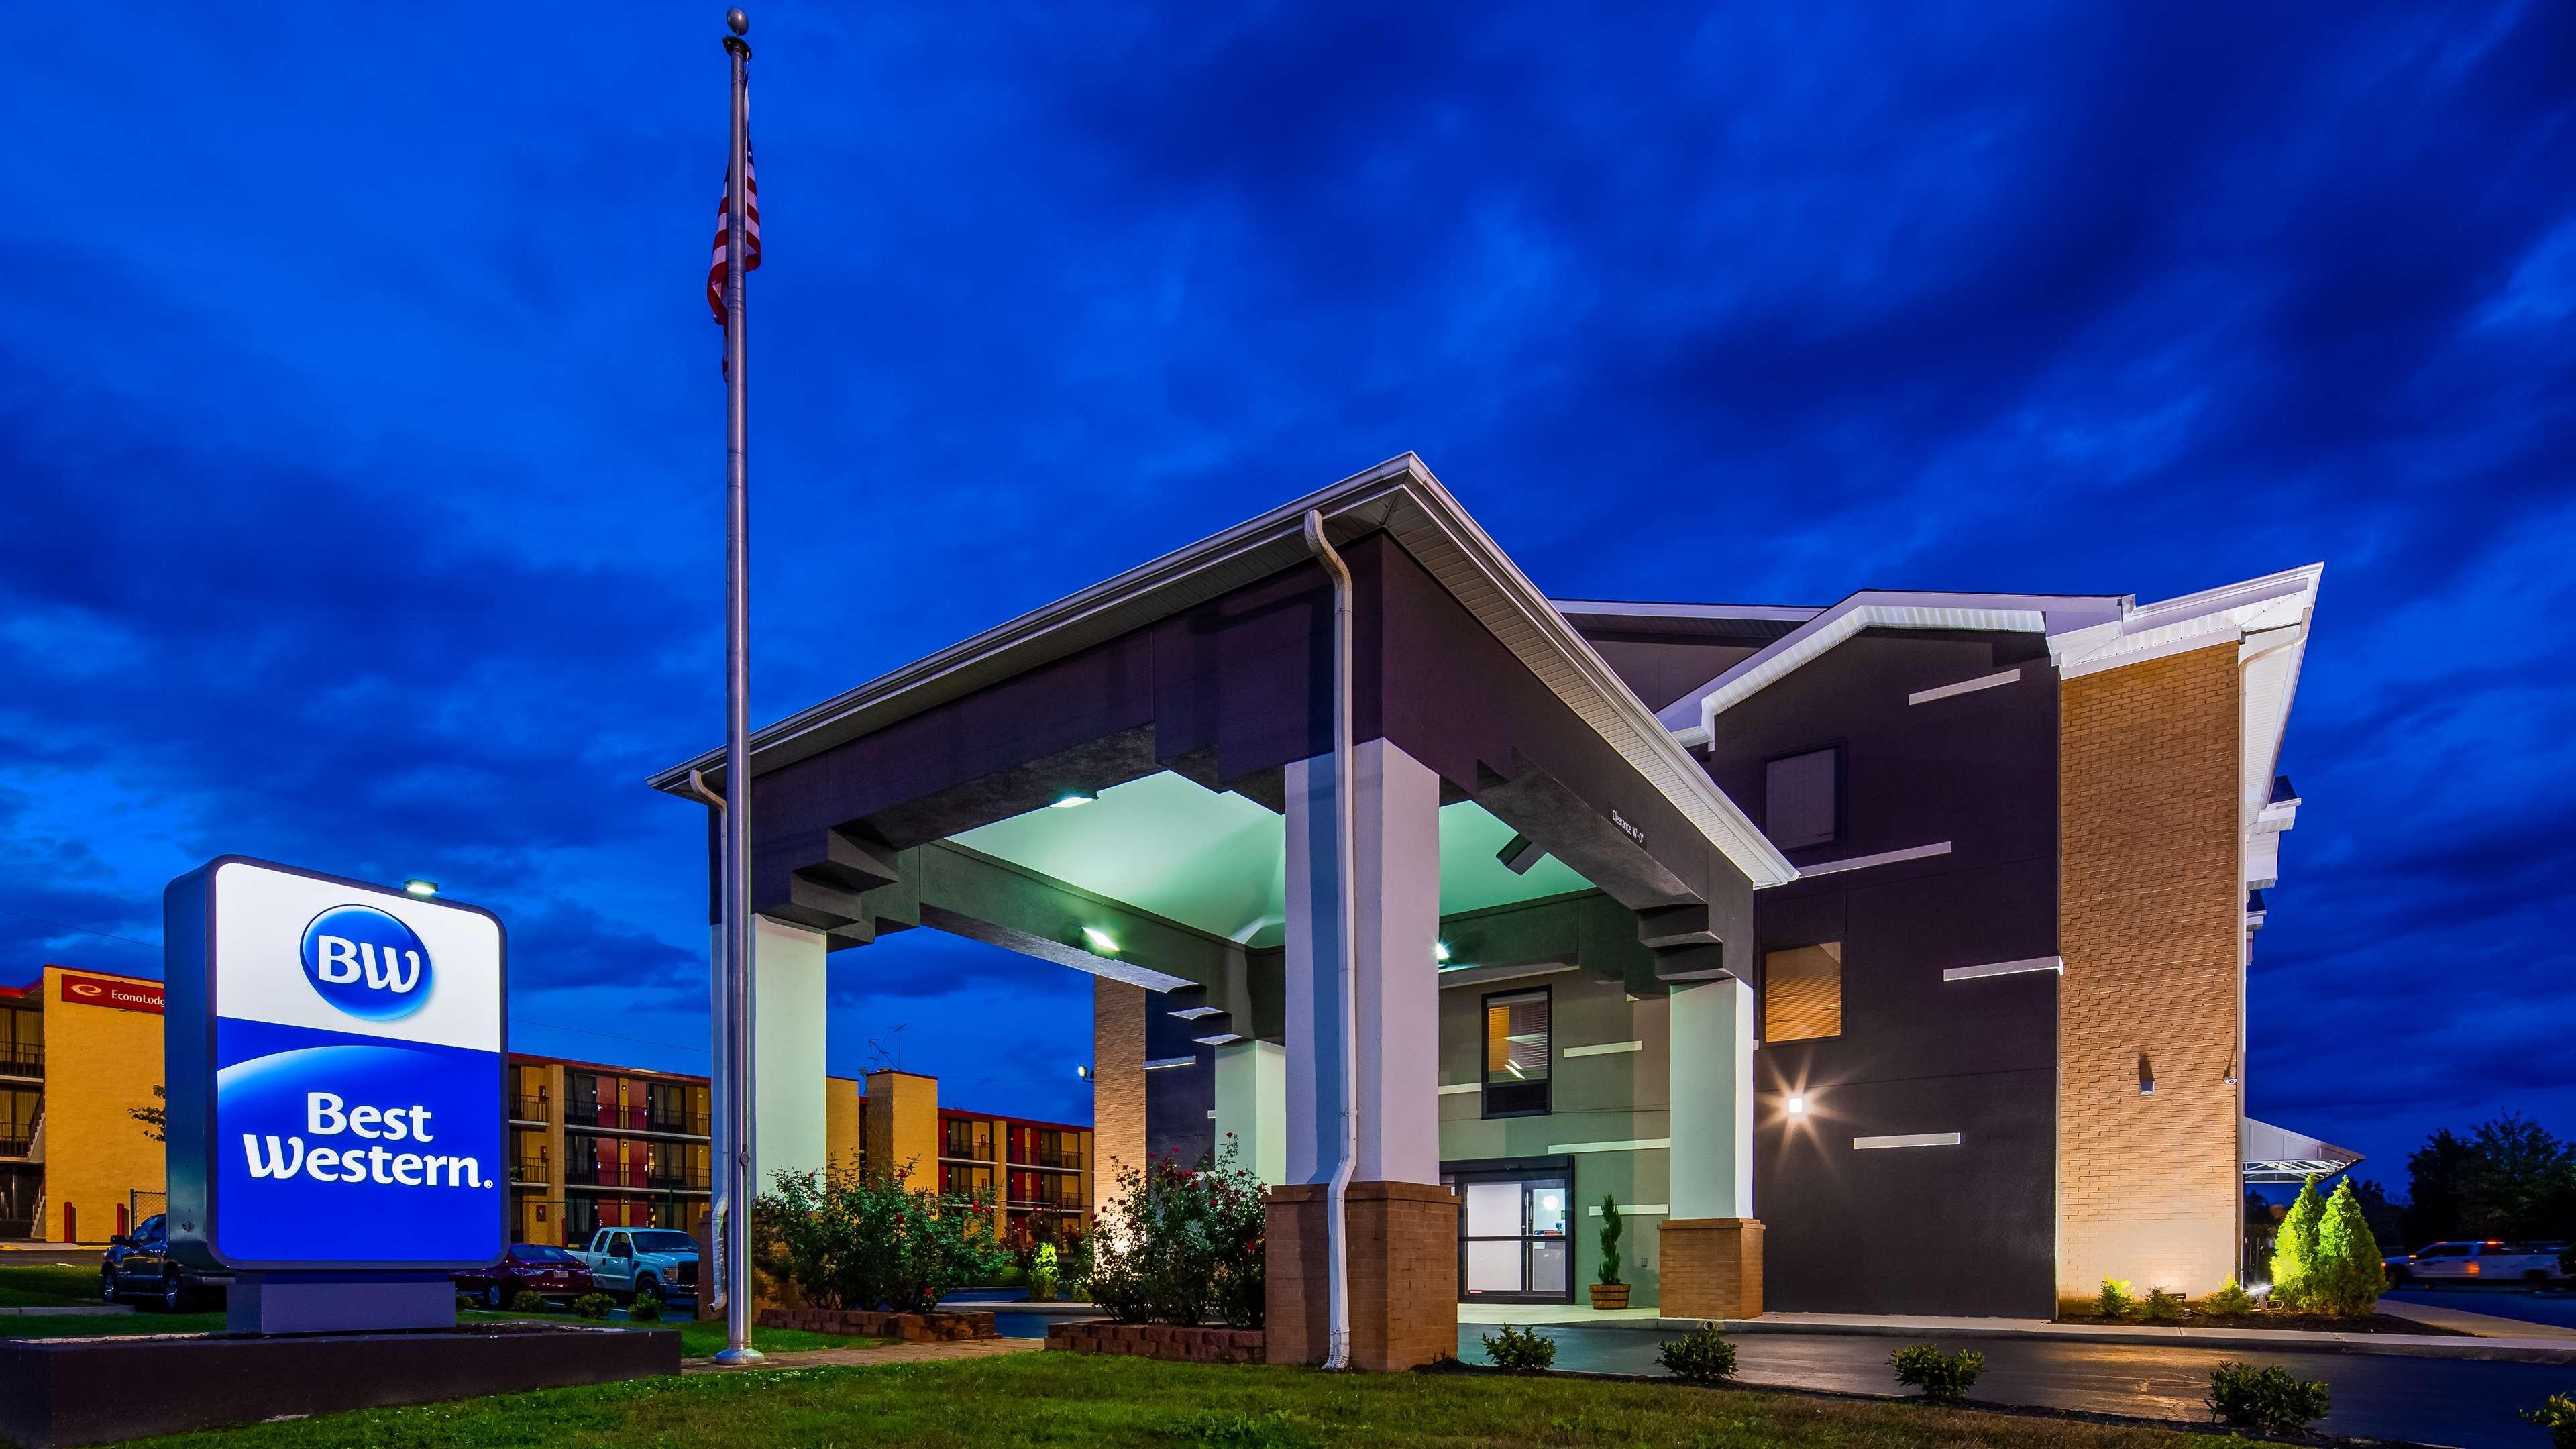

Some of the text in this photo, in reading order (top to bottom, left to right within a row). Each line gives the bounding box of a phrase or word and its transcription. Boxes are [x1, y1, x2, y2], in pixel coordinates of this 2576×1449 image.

[318, 934, 421, 993] BW
[111, 989, 165, 1008] EconoLodg
[307, 1092, 433, 1142] Best
